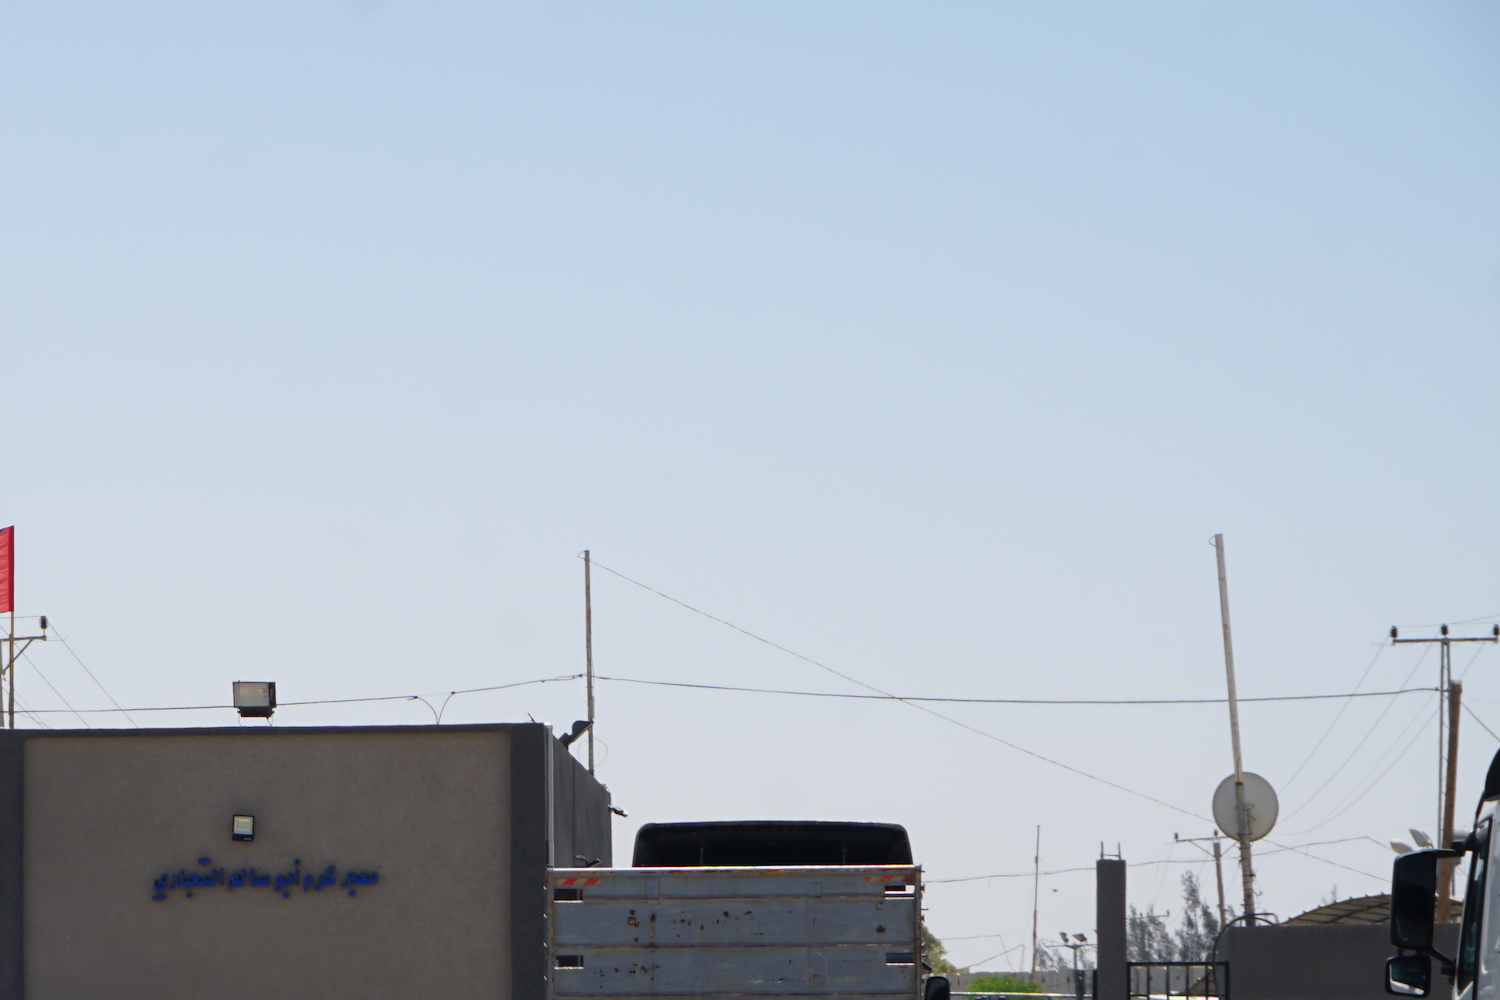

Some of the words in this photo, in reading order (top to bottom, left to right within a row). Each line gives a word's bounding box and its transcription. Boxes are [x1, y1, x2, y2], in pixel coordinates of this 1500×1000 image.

[152, 856, 225, 901] التجاري
[228, 867, 270, 892] سالم
[303, 865, 336, 892] كرم
[340, 870, 379, 897] معبر
